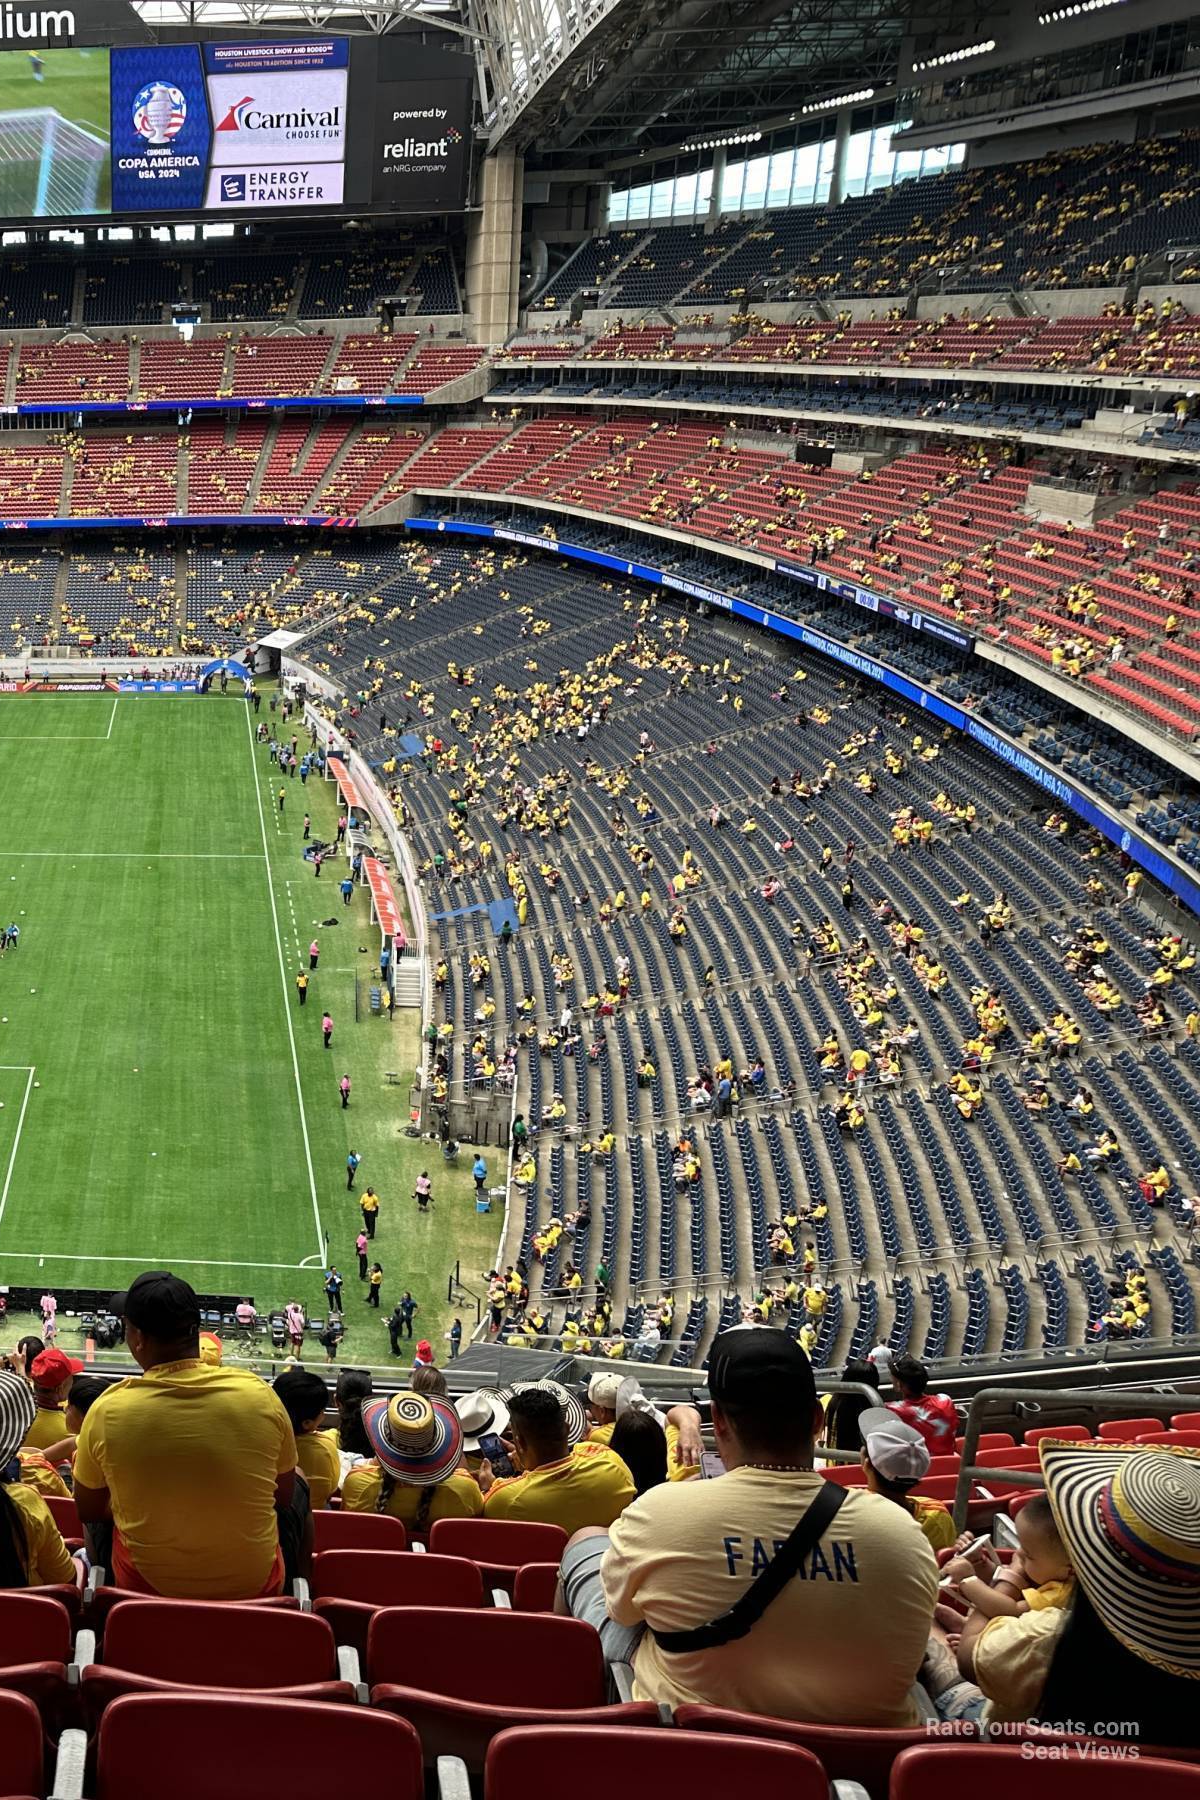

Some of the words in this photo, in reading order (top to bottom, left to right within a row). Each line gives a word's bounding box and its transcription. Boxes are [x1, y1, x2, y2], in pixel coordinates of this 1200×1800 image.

[245, 106, 340, 130] Carnival
[393, 109, 436, 121] powered
[436, 108, 448, 120] by
[286, 130, 320, 140] CHOOSE
[324, 129, 340, 139] FUN
[384, 137, 448, 158] reliant
[119, 158, 148, 169] COPA
[150, 156, 200, 168] AMERICA
[382, 165, 392, 173] an
[393, 164, 410, 172] NRG
[412, 164, 446, 174] company
[138, 170, 156, 179] USA
[158, 169, 180, 178] 2024
[250, 171, 309, 186] ENERGY
[250, 186, 324, 200] TRANSFER
[968, 721, 999, 751] CONMEBOL
[1000, 742, 1016, 763] COPA
[1014, 753, 1044, 783] AMERICA
[1044, 772, 1056, 794] USA
[1056, 780, 1072, 804] 2024
